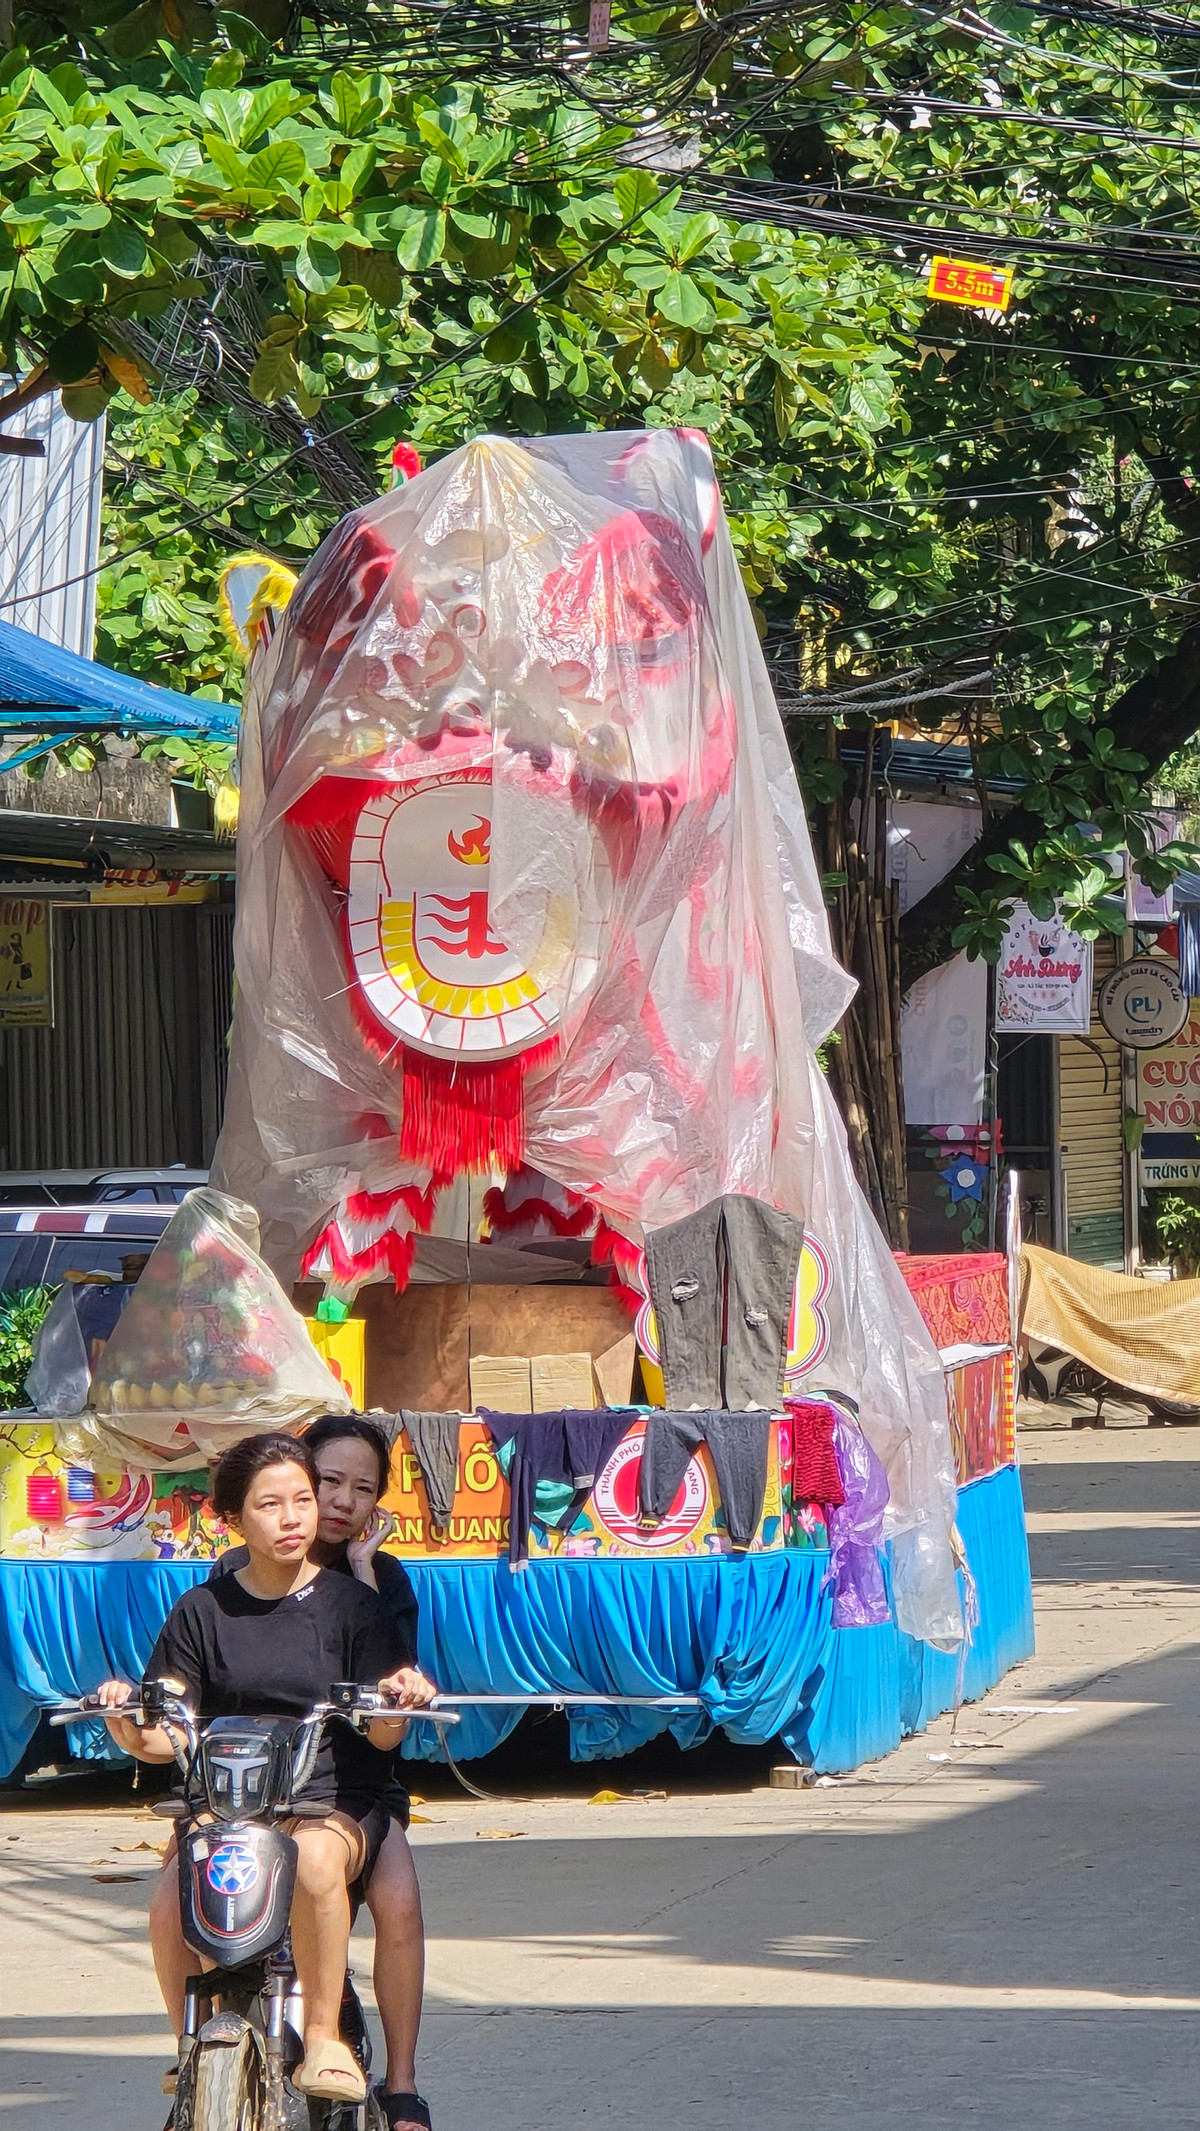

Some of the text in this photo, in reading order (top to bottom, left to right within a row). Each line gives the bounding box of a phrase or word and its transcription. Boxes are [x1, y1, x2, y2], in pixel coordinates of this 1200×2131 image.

[945, 271, 994, 297] 5.5m
[1131, 996, 1155, 1013] PL
[1144, 1162, 1189, 1181] TRỨNG
[402, 1440, 498, 1493] PỐ
